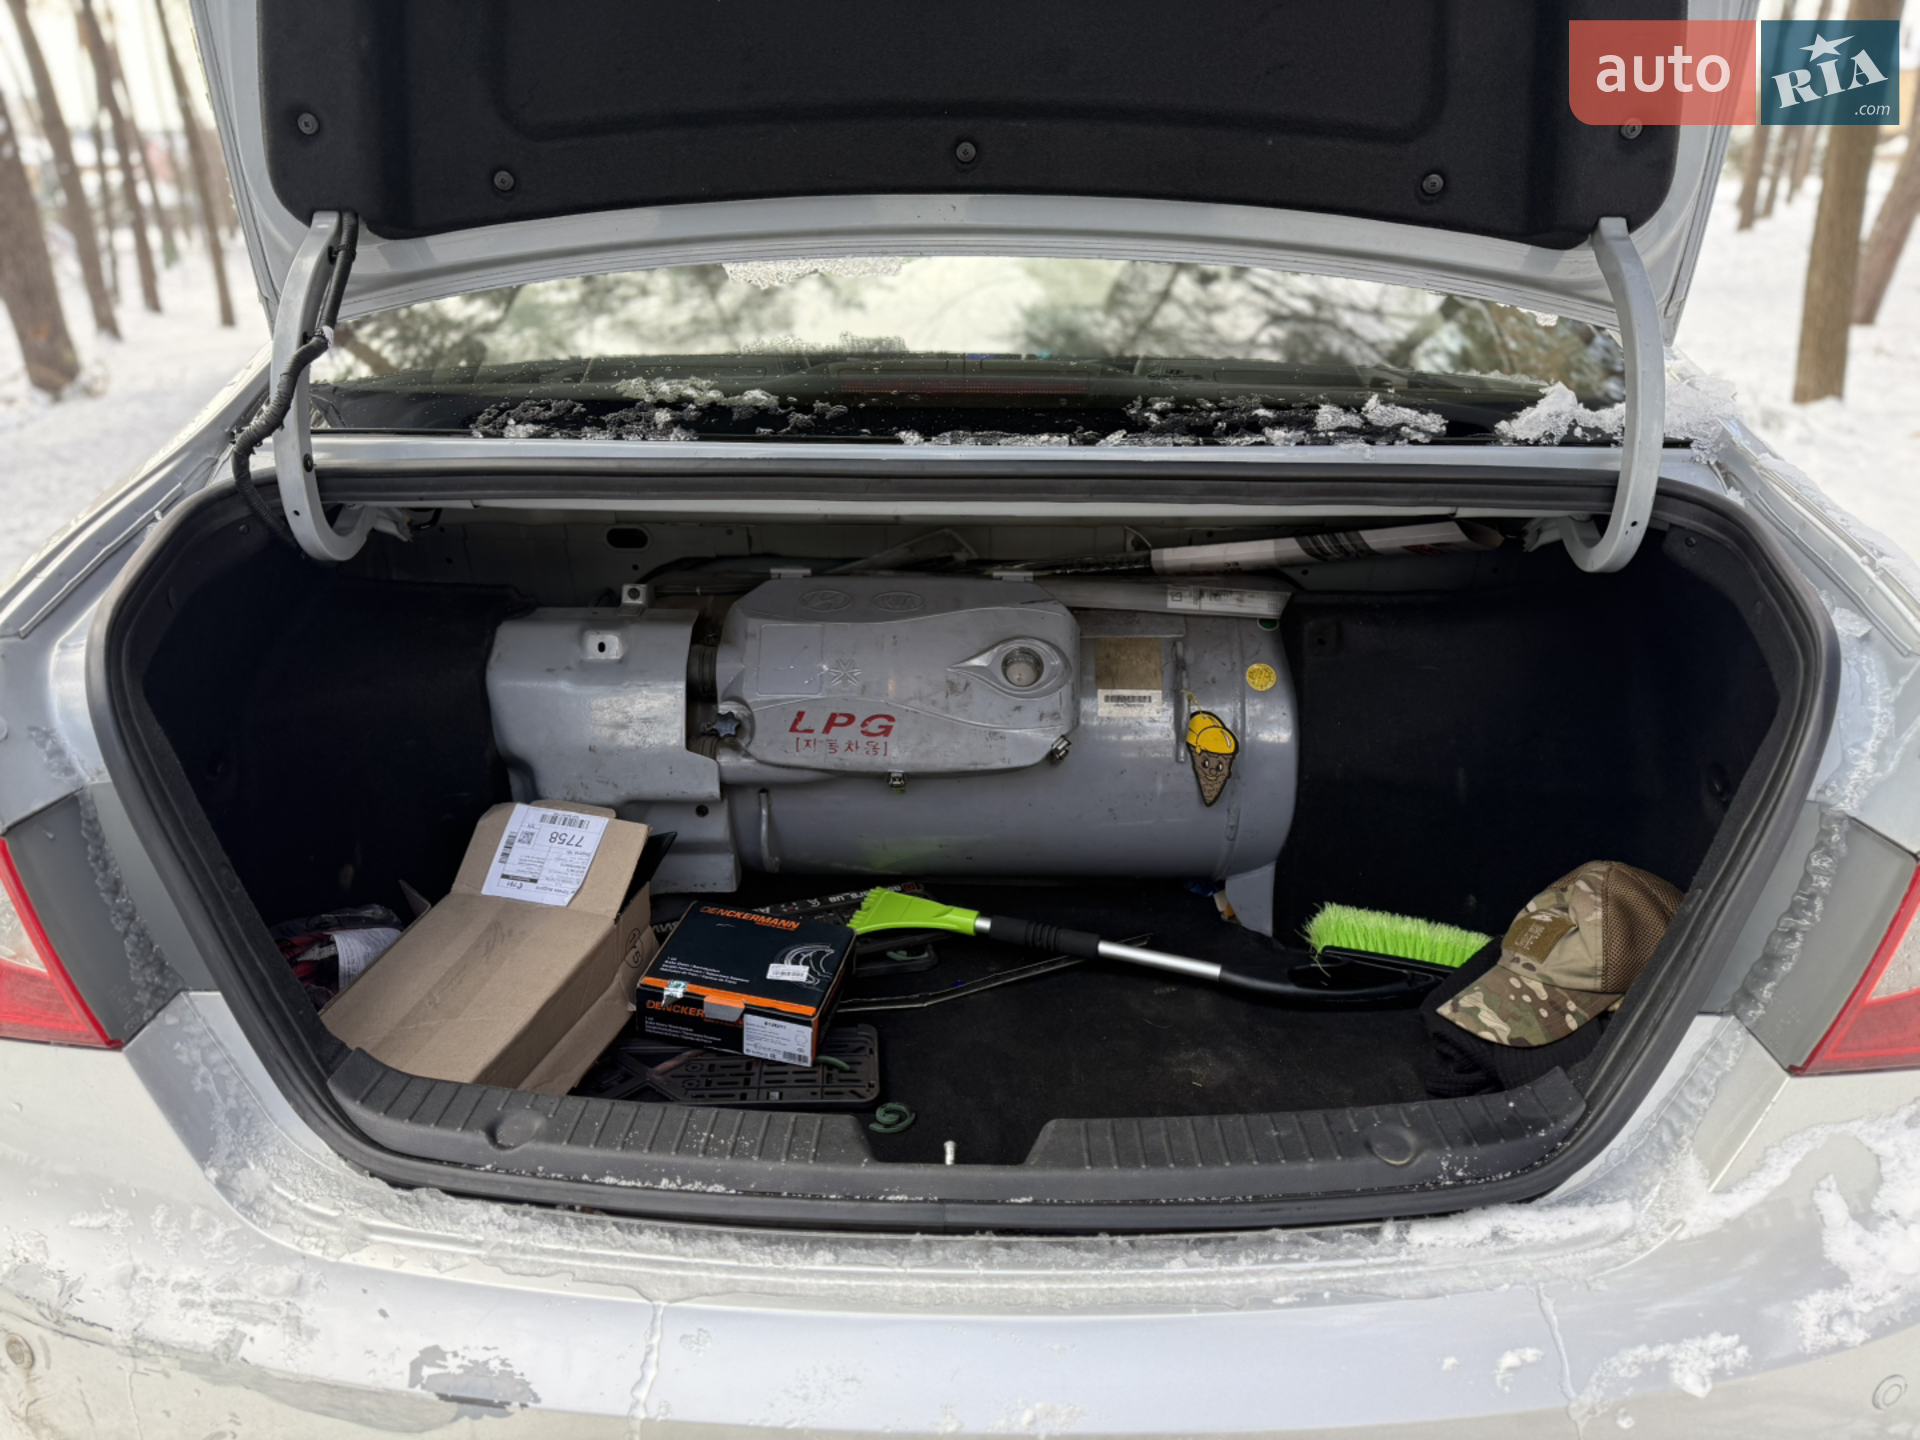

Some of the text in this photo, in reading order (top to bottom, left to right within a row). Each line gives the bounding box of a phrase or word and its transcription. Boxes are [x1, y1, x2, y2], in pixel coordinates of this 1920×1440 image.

[788, 710, 897, 738] LPG
[548, 831, 585, 848] 7758
[700, 905, 803, 929] DENCKERMANN
